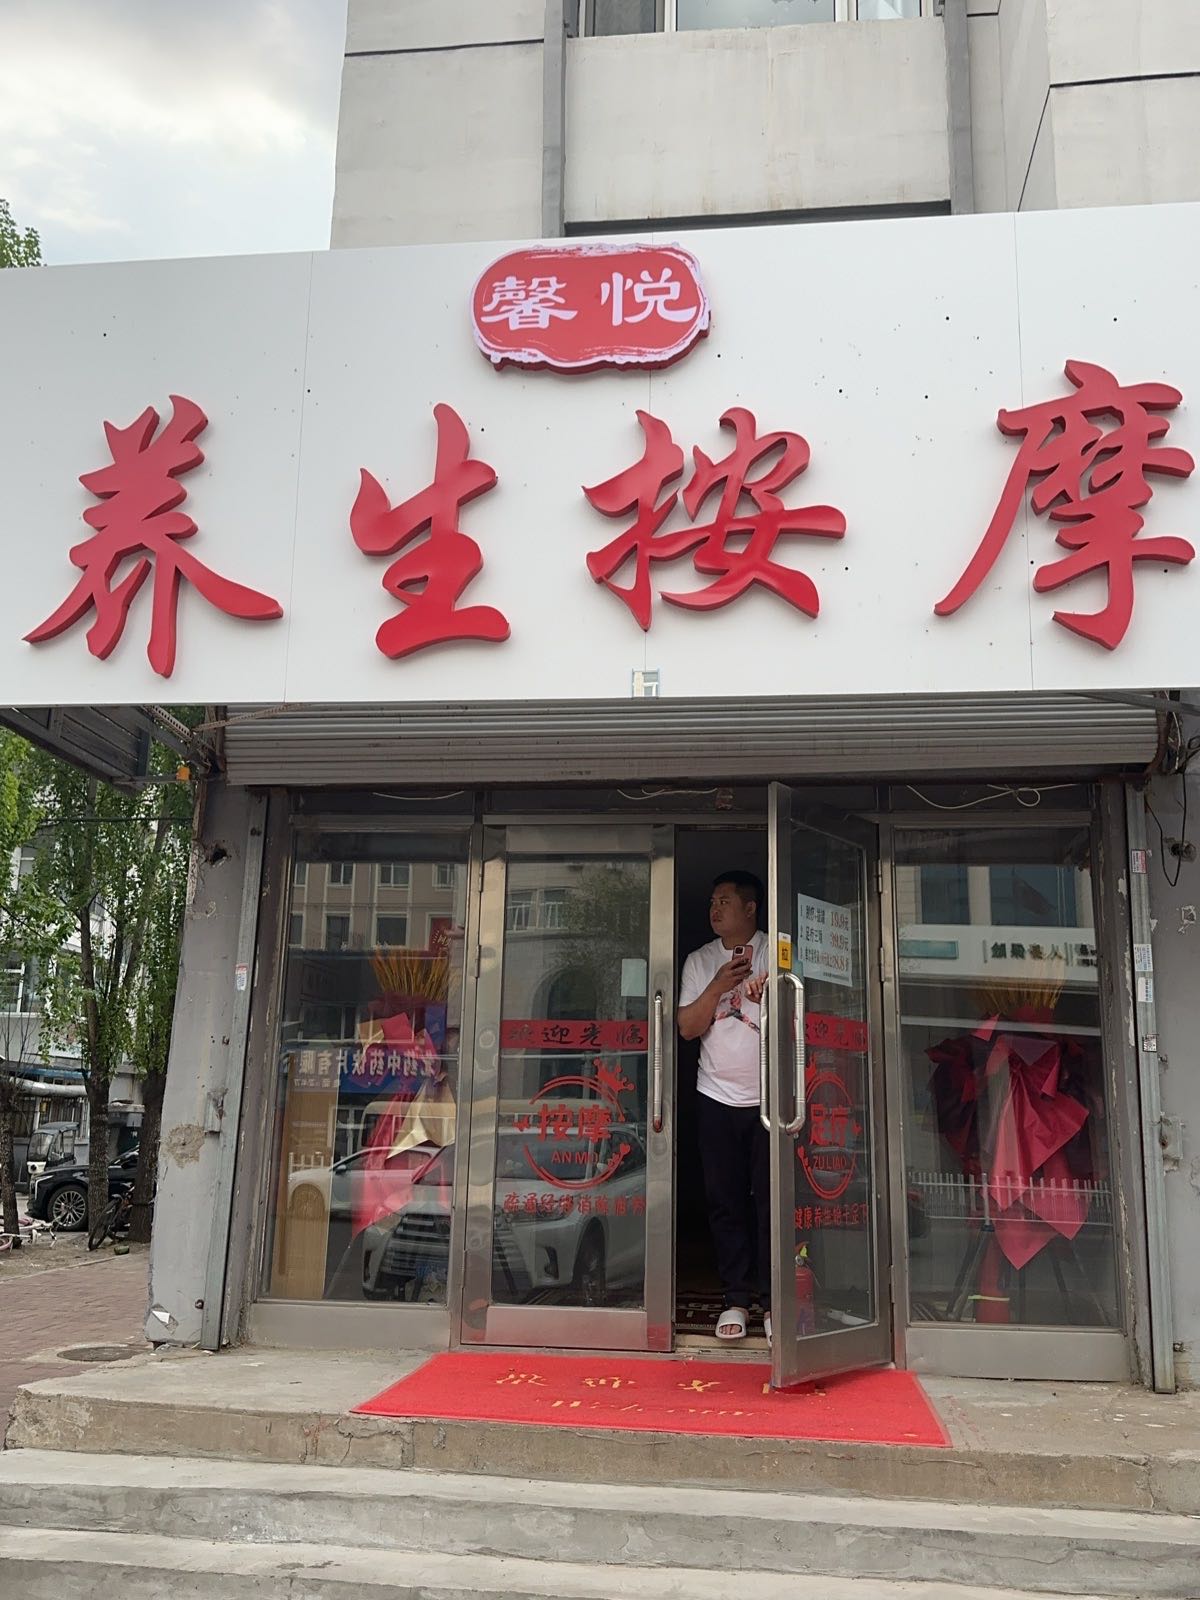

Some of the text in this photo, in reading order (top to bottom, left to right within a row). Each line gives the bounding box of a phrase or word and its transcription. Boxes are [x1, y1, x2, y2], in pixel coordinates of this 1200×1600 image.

[480, 267, 698, 331] 馨悦
[22, 360, 1195, 678] 养生按摩
[508, 1022, 645, 1047] 欢迎光临
[537, 1103, 612, 1143] 按摩
[810, 1103, 849, 1146] 足疗
[551, 1151, 572, 1163] AN
[813, 1155, 824, 1169] ZU
